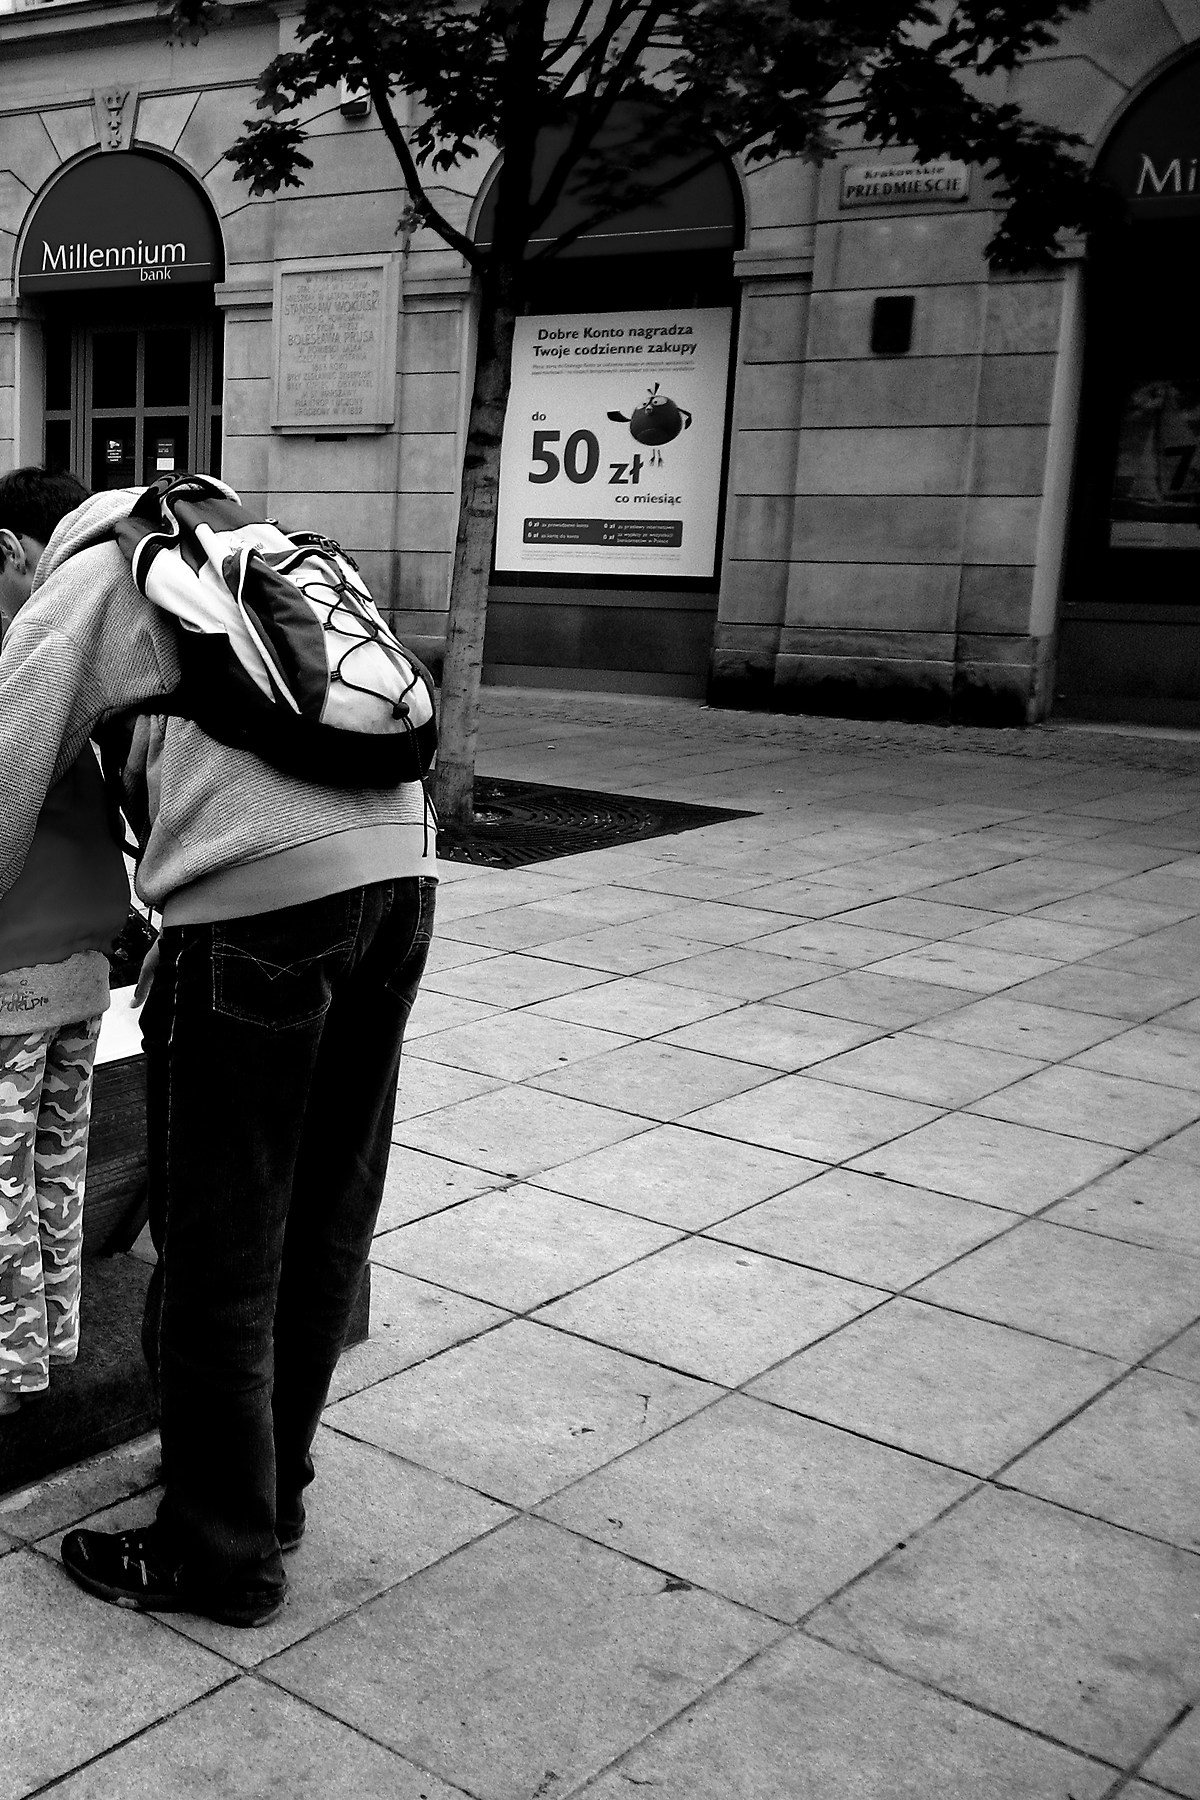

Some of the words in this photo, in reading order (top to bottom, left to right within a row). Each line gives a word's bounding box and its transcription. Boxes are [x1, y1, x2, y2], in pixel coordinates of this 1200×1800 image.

[42, 239, 186, 271] Millennium
[140, 266, 171, 281] bank
[538, 328, 579, 341] Dobre
[583, 327, 624, 339] Konto
[628, 324, 693, 339] nagradza
[532, 345, 571, 359] Twoje
[574, 343, 643, 356] codzienne
[647, 341, 697, 356] zakupy
[531, 411, 547, 422] do
[528, 429, 600, 485] 50
[608, 454, 644, 485] zł
[615, 494, 630, 504] co
[633, 493, 682, 506] miesiąc
